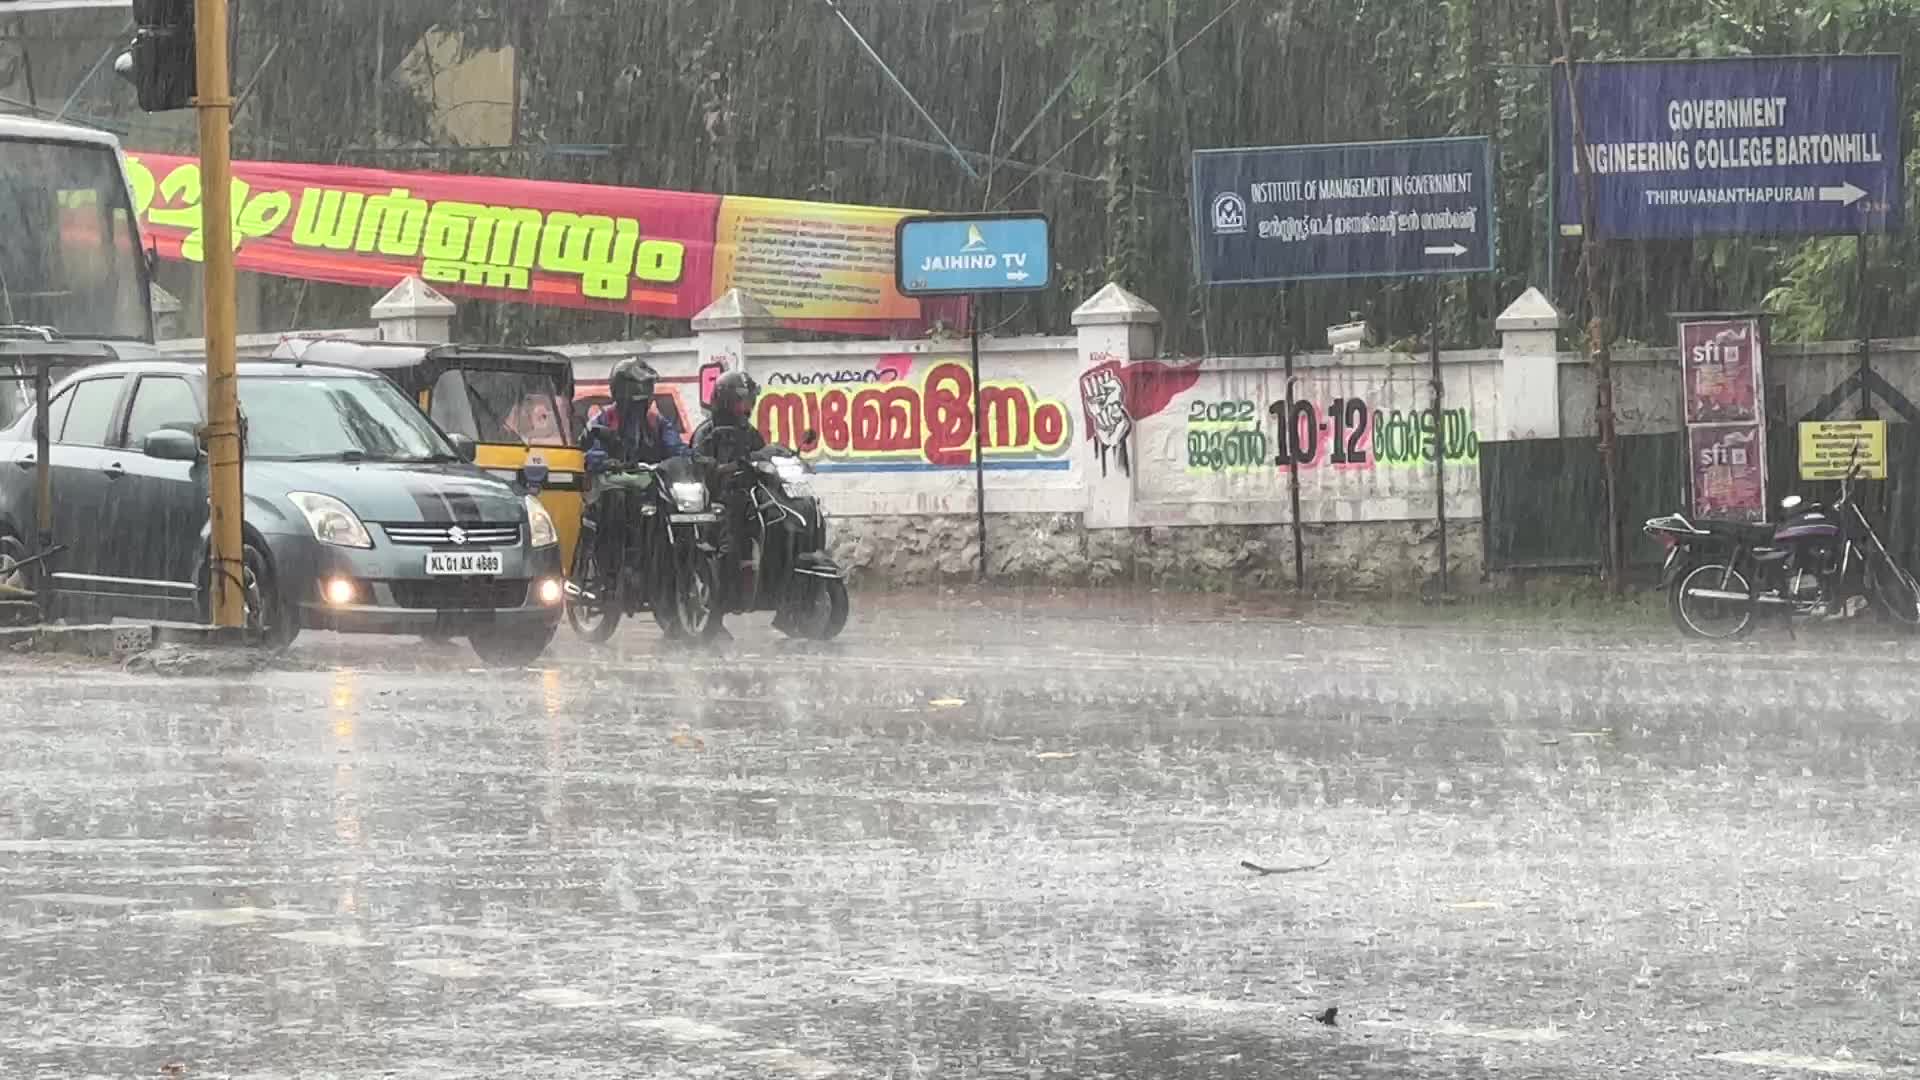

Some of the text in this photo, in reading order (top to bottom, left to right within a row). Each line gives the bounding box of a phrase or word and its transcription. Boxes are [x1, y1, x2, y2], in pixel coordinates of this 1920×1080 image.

[1668, 98, 1787, 131] GOVERNMENT
[1695, 137, 1774, 170] COLLEGE
[1775, 133, 1882, 166] BARTONHILL
[1250, 173, 1472, 203] INSTITUTE OF MANAGEMENT IN GOVERNMENT
[1645, 187, 1815, 205] THIRUVANANTHAPURAM
[921, 253, 1027, 272] JAIHIND TV
[1692, 340, 1720, 364] sfi
[756, 363, 1065, 466] സമ്മേളനം
[1188, 400, 1255, 422] 2022
[1269, 397, 1368, 466] 10-12
[1701, 442, 1728, 465] sfi
[432, 556, 445, 571] KL
[446, 556, 457, 571] 01
[461, 556, 473, 570] AX
